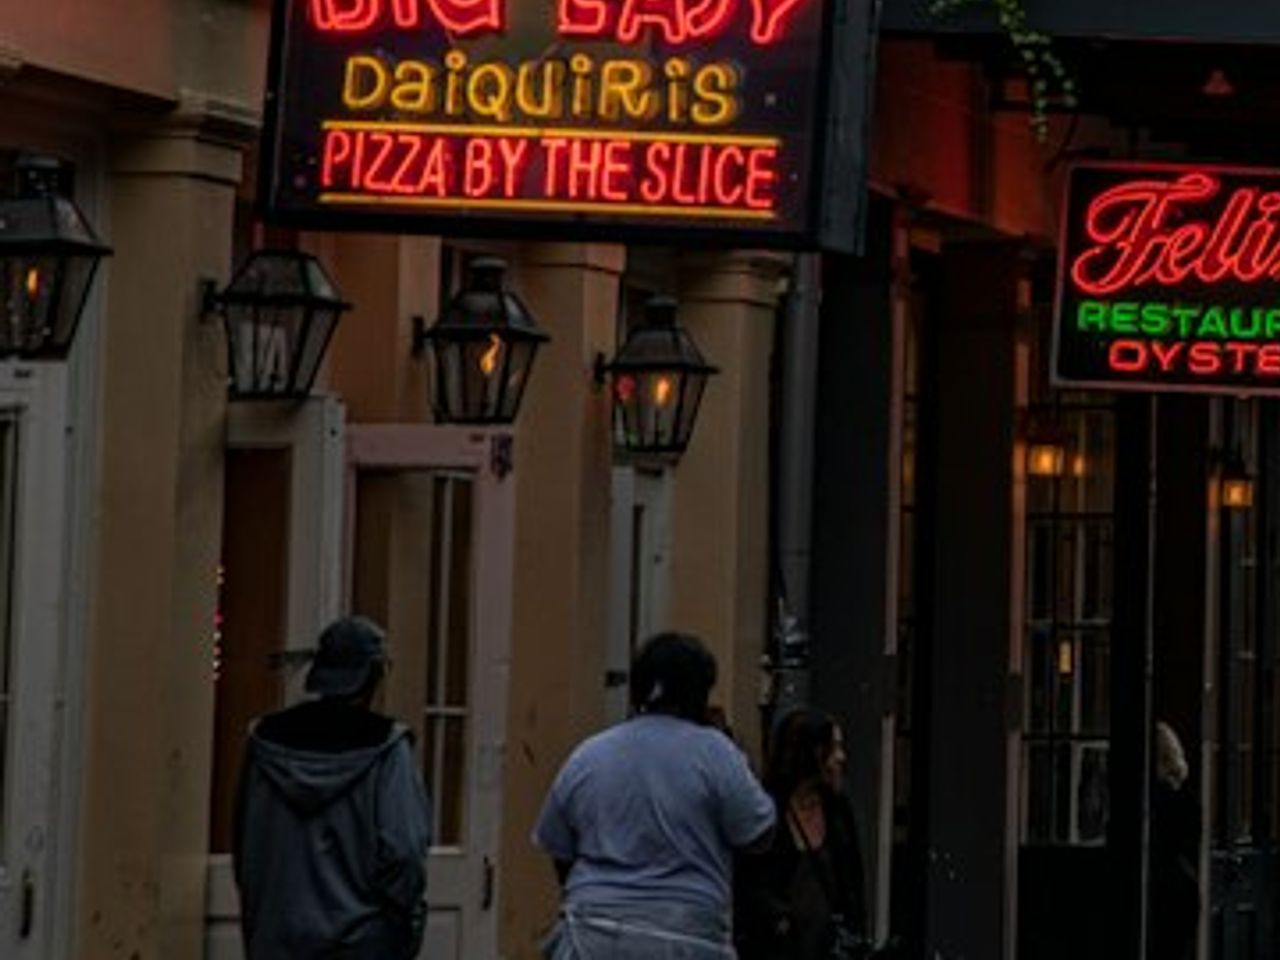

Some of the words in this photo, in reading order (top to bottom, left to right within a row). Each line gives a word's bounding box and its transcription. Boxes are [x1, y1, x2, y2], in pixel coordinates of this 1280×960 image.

[321, 131, 447, 197] PIZZA
[464, 139, 529, 198] BY
[541, 139, 633, 201] THE
[640, 143, 778, 208] SLICE
